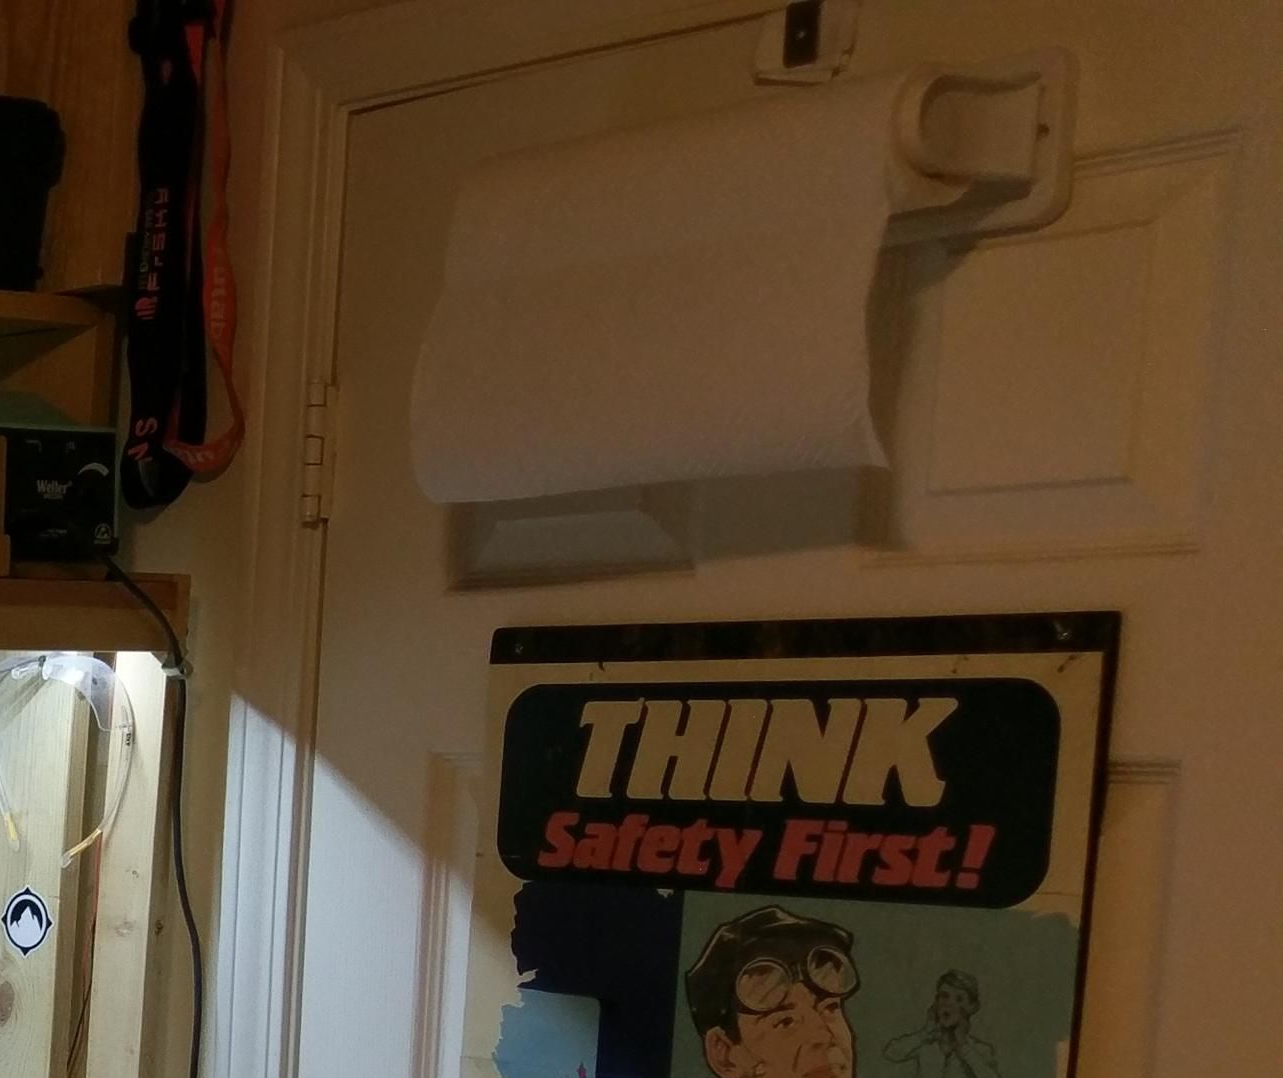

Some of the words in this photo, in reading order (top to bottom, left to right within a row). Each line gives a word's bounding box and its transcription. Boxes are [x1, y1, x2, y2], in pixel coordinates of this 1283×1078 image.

[36, 479, 68, 495] Weller
[575, 696, 959, 808] THINK
[538, 810, 763, 890] Safety
[773, 819, 997, 890] First!
